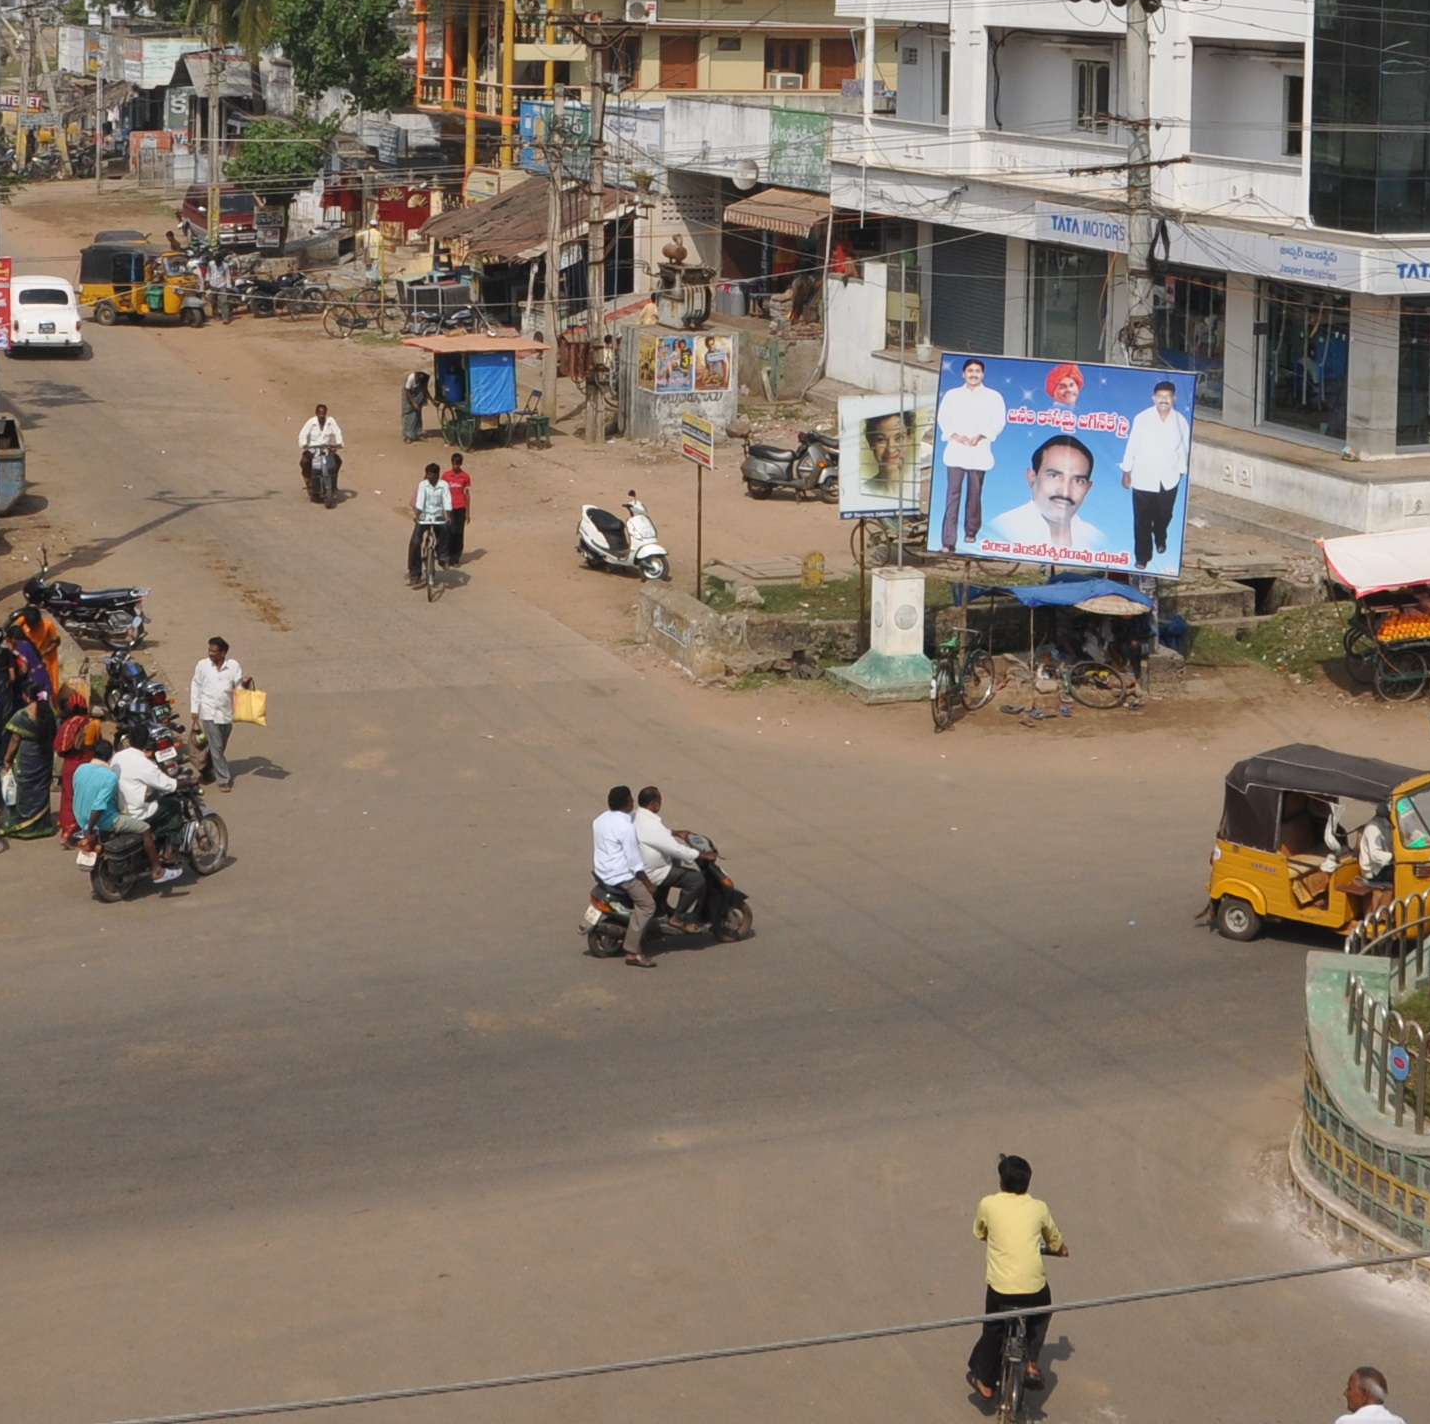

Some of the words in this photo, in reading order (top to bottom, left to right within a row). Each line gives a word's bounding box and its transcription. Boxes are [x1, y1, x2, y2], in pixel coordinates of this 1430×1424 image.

[1051, 214, 1079, 234] TATA
[1082, 221, 1126, 242] MOTORS
[1279, 264, 1302, 278] Jasper
[1008, 408, 1036, 424] జనం
[981, 539, 1010, 553] వంకా
